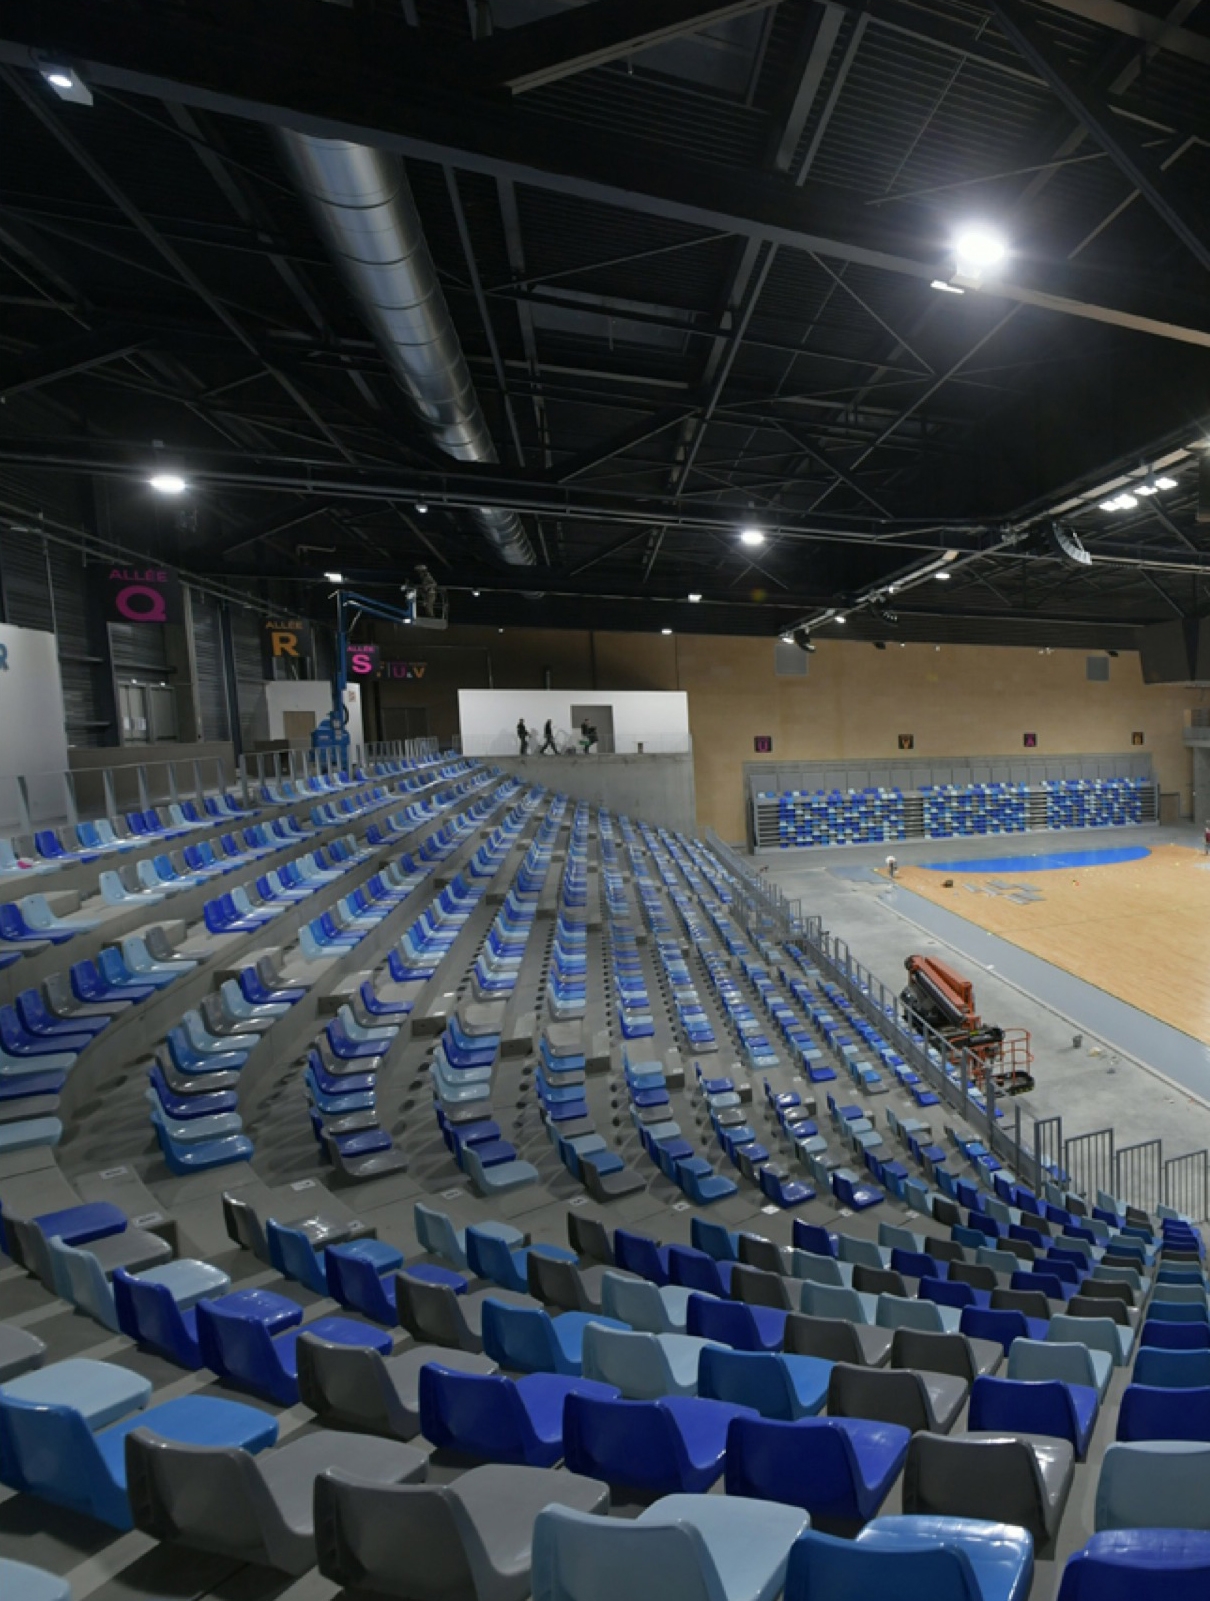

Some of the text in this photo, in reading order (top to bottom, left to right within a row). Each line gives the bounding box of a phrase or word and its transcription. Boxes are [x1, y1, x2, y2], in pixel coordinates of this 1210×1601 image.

[109, 568, 168, 582] ALLÉE
[116, 584, 167, 622] Q
[271, 631, 299, 656] R
[352, 654, 373, 674] S
